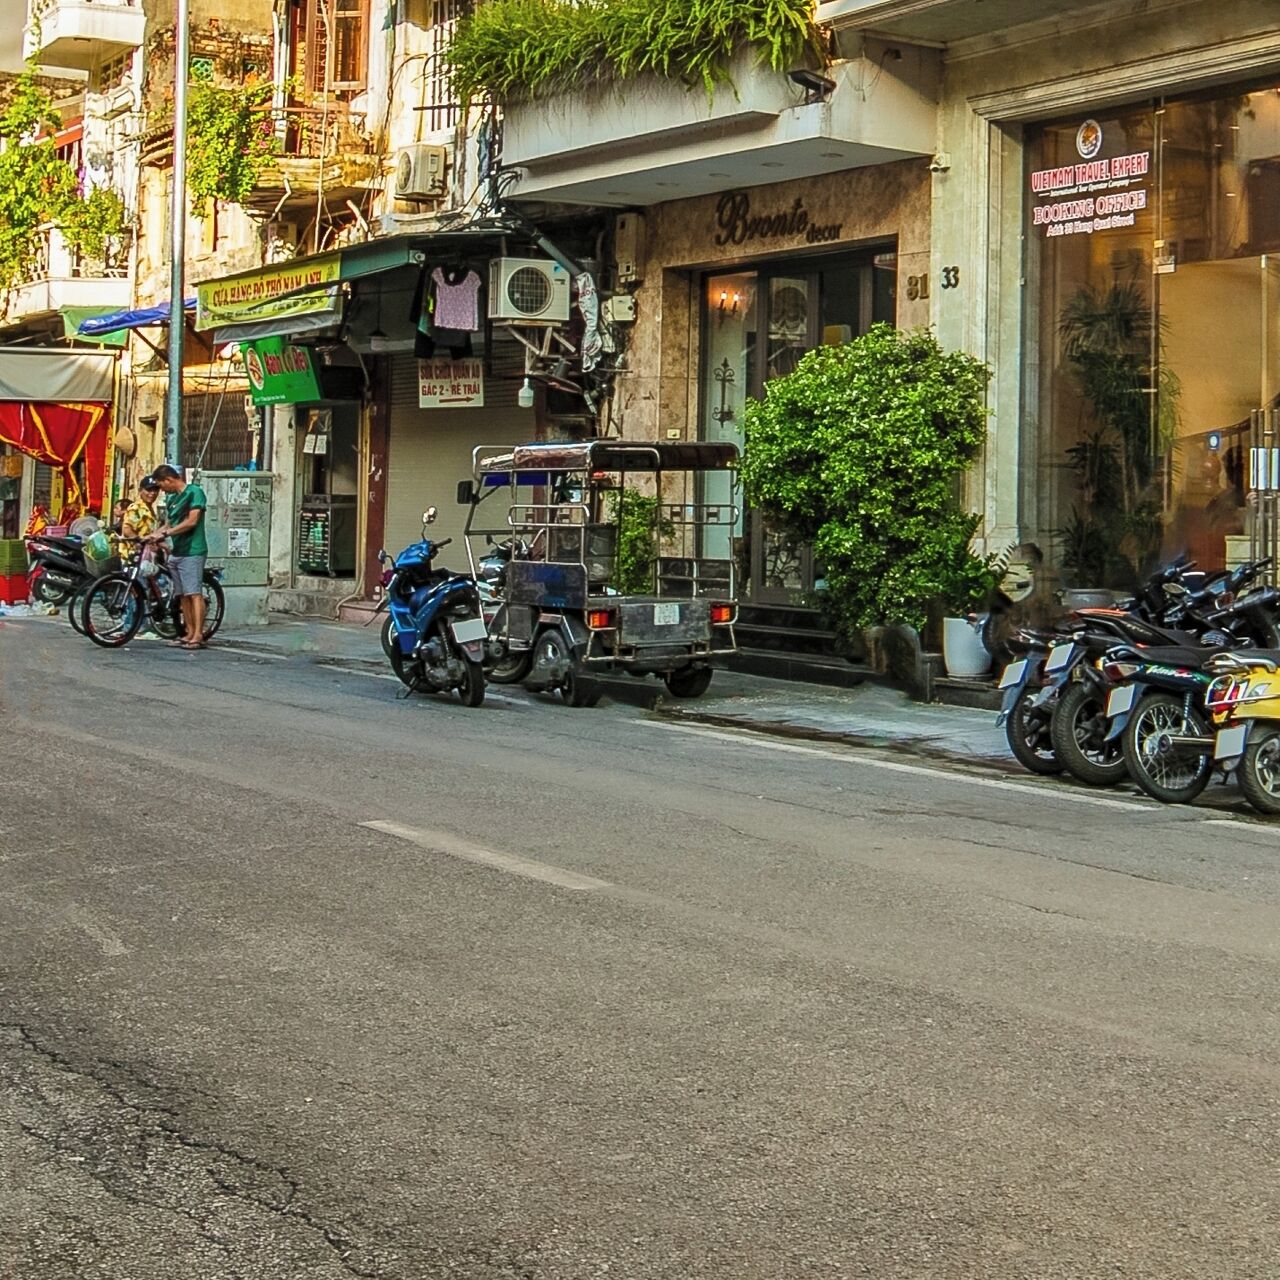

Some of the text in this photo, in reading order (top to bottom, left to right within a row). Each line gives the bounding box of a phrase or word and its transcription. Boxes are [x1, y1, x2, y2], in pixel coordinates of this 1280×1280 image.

[1032, 152, 1149, 192] VIETNAM TRAVEL EXPERT
[1033, 190, 1146, 225] BOOKING OFFICE
[1112, 213, 1135, 227] Street
[941, 266, 959, 289] 33
[421, 383, 437, 396] GÁC
[439, 385, 444, 396] 2
[463, 381, 480, 395] TRÁI
